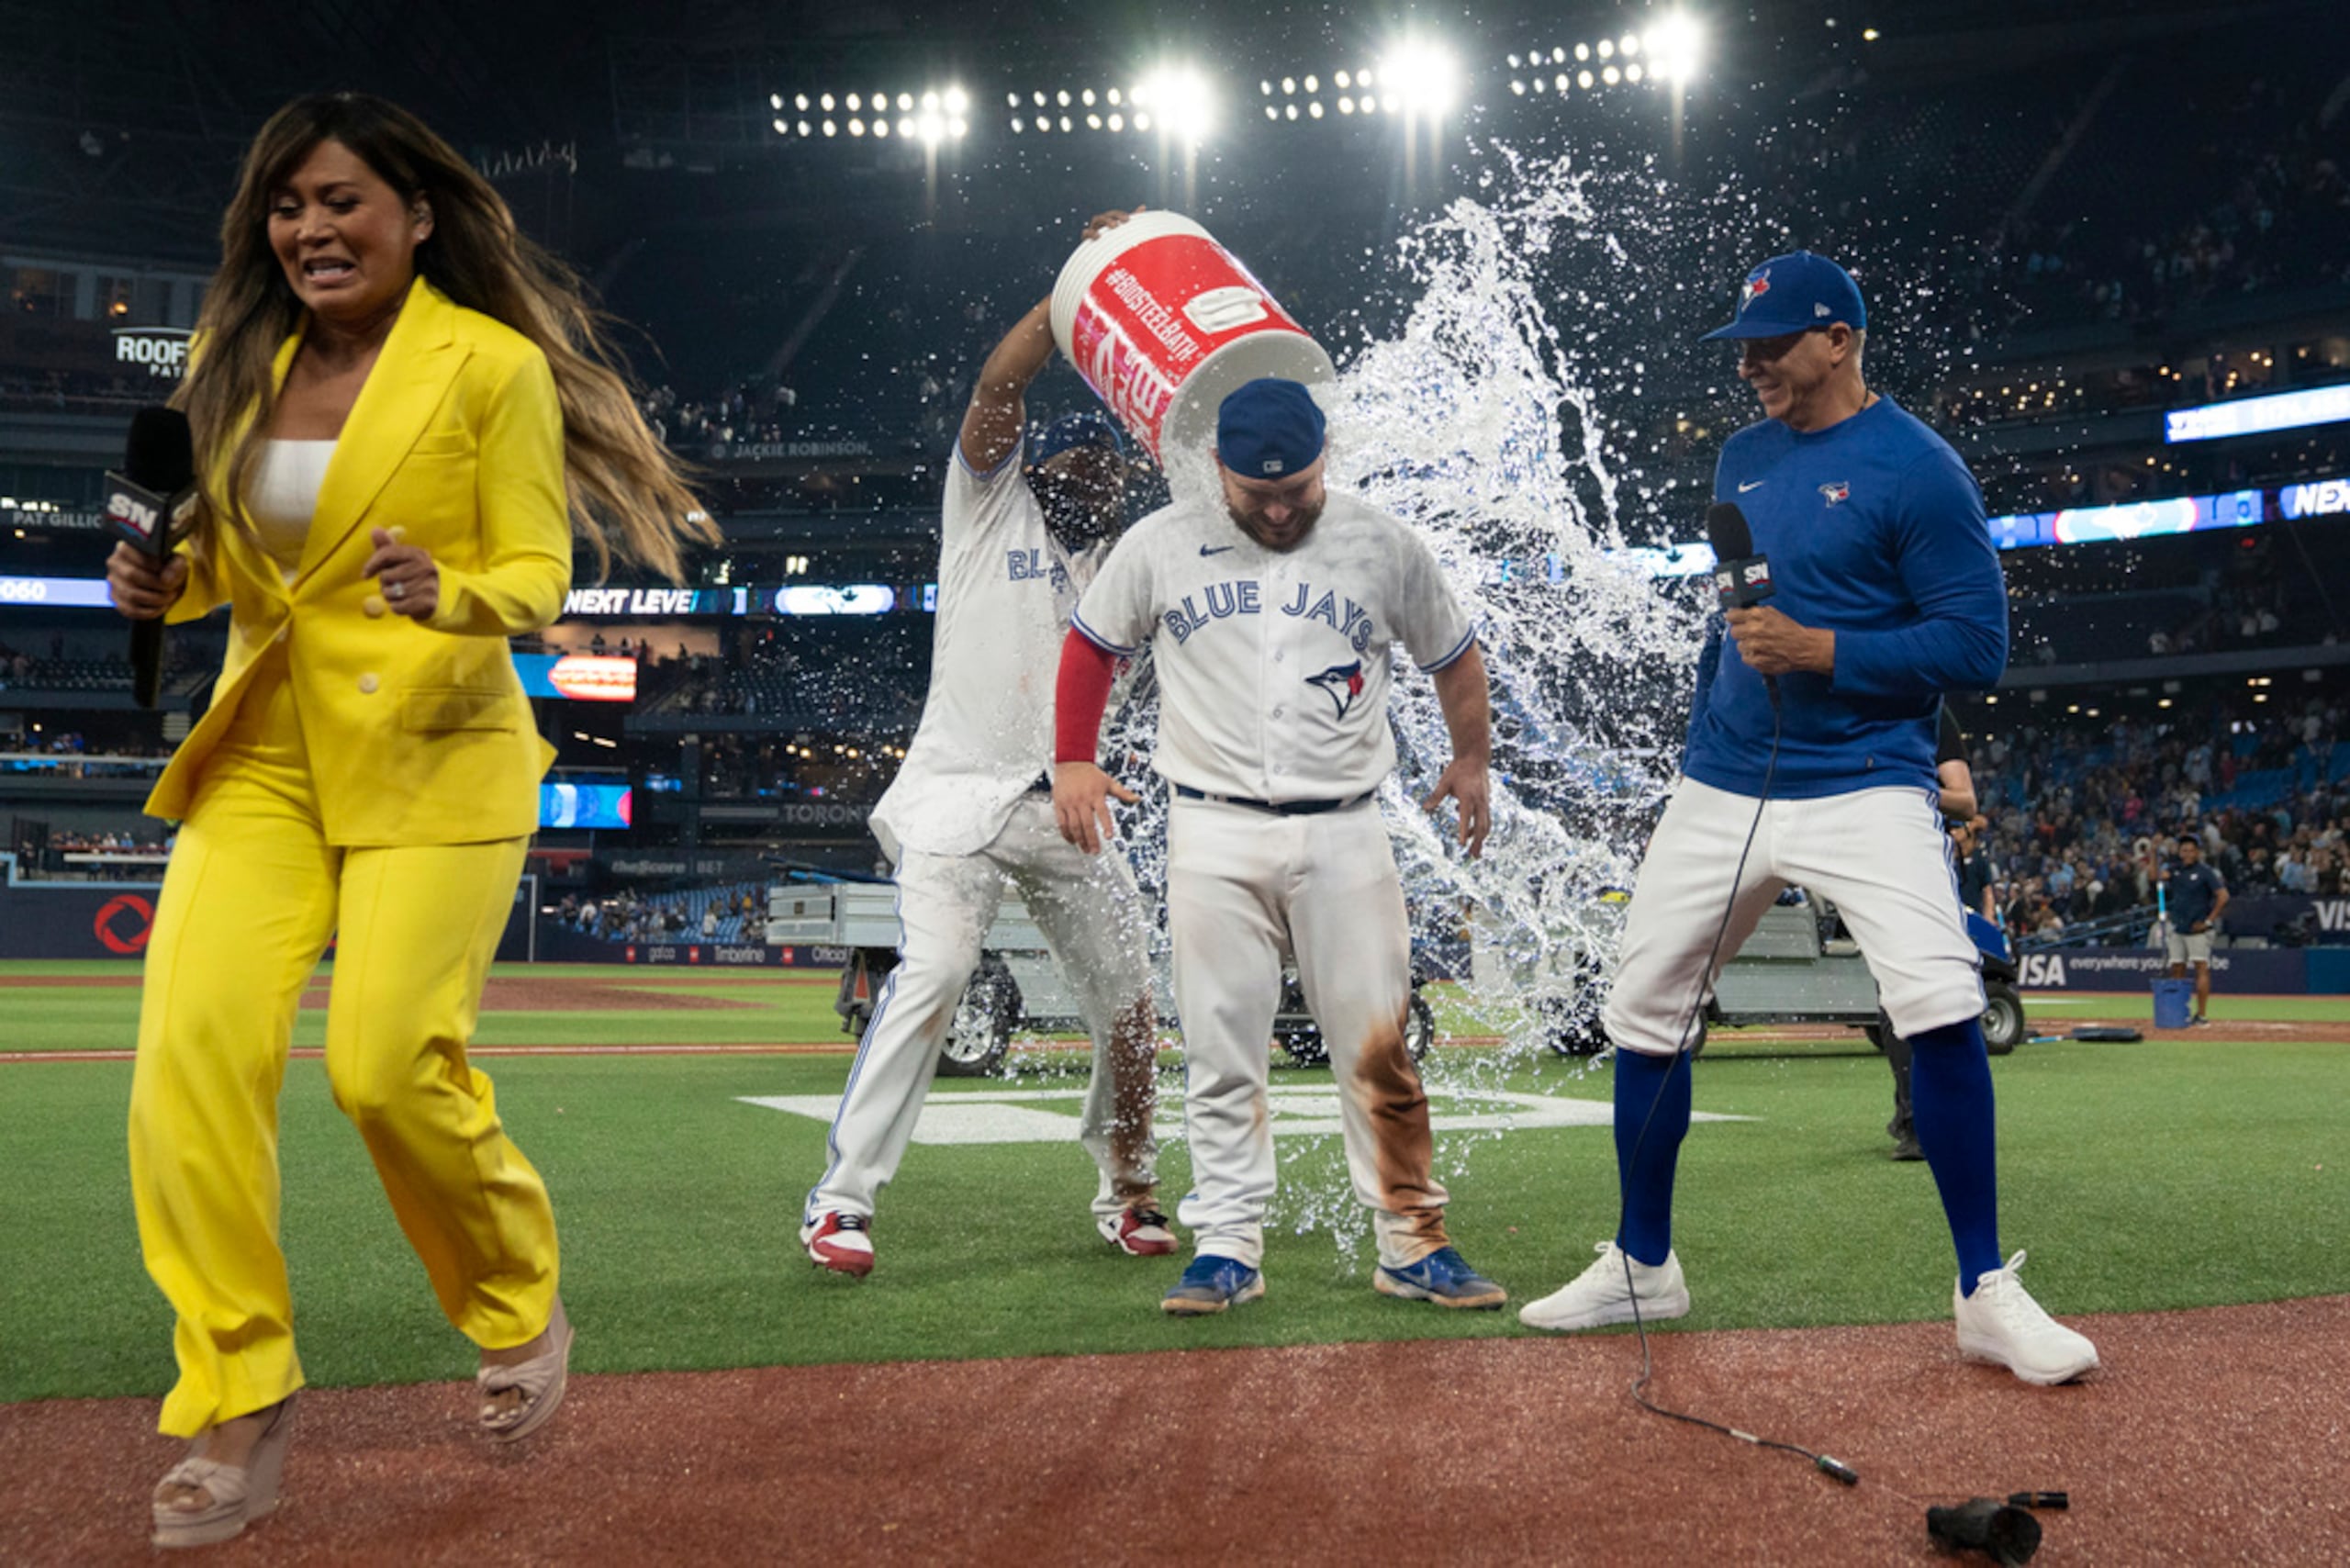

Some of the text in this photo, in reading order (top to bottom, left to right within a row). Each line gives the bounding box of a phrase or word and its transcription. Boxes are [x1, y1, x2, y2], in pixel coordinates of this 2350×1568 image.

[1104, 267, 1199, 362] #BIOSTEELBATH
[116, 335, 192, 364] ROOF
[150, 364, 188, 378] PAT
[735, 442, 868, 458] JACKIE ROBINSON
[13, 510, 102, 529] PAT GILLIC
[107, 492, 158, 534] SN
[1743, 562, 1769, 584] SN
[0, 578, 47, 602] 060
[563, 588, 630, 614] NEXT
[1164, 581, 1374, 652] BLUE JAYS
[610, 858, 724, 875] theScore BET
[2310, 901, 2350, 931] VI
[2017, 954, 2066, 987] ISA
[2068, 955, 2137, 972] everywhere
